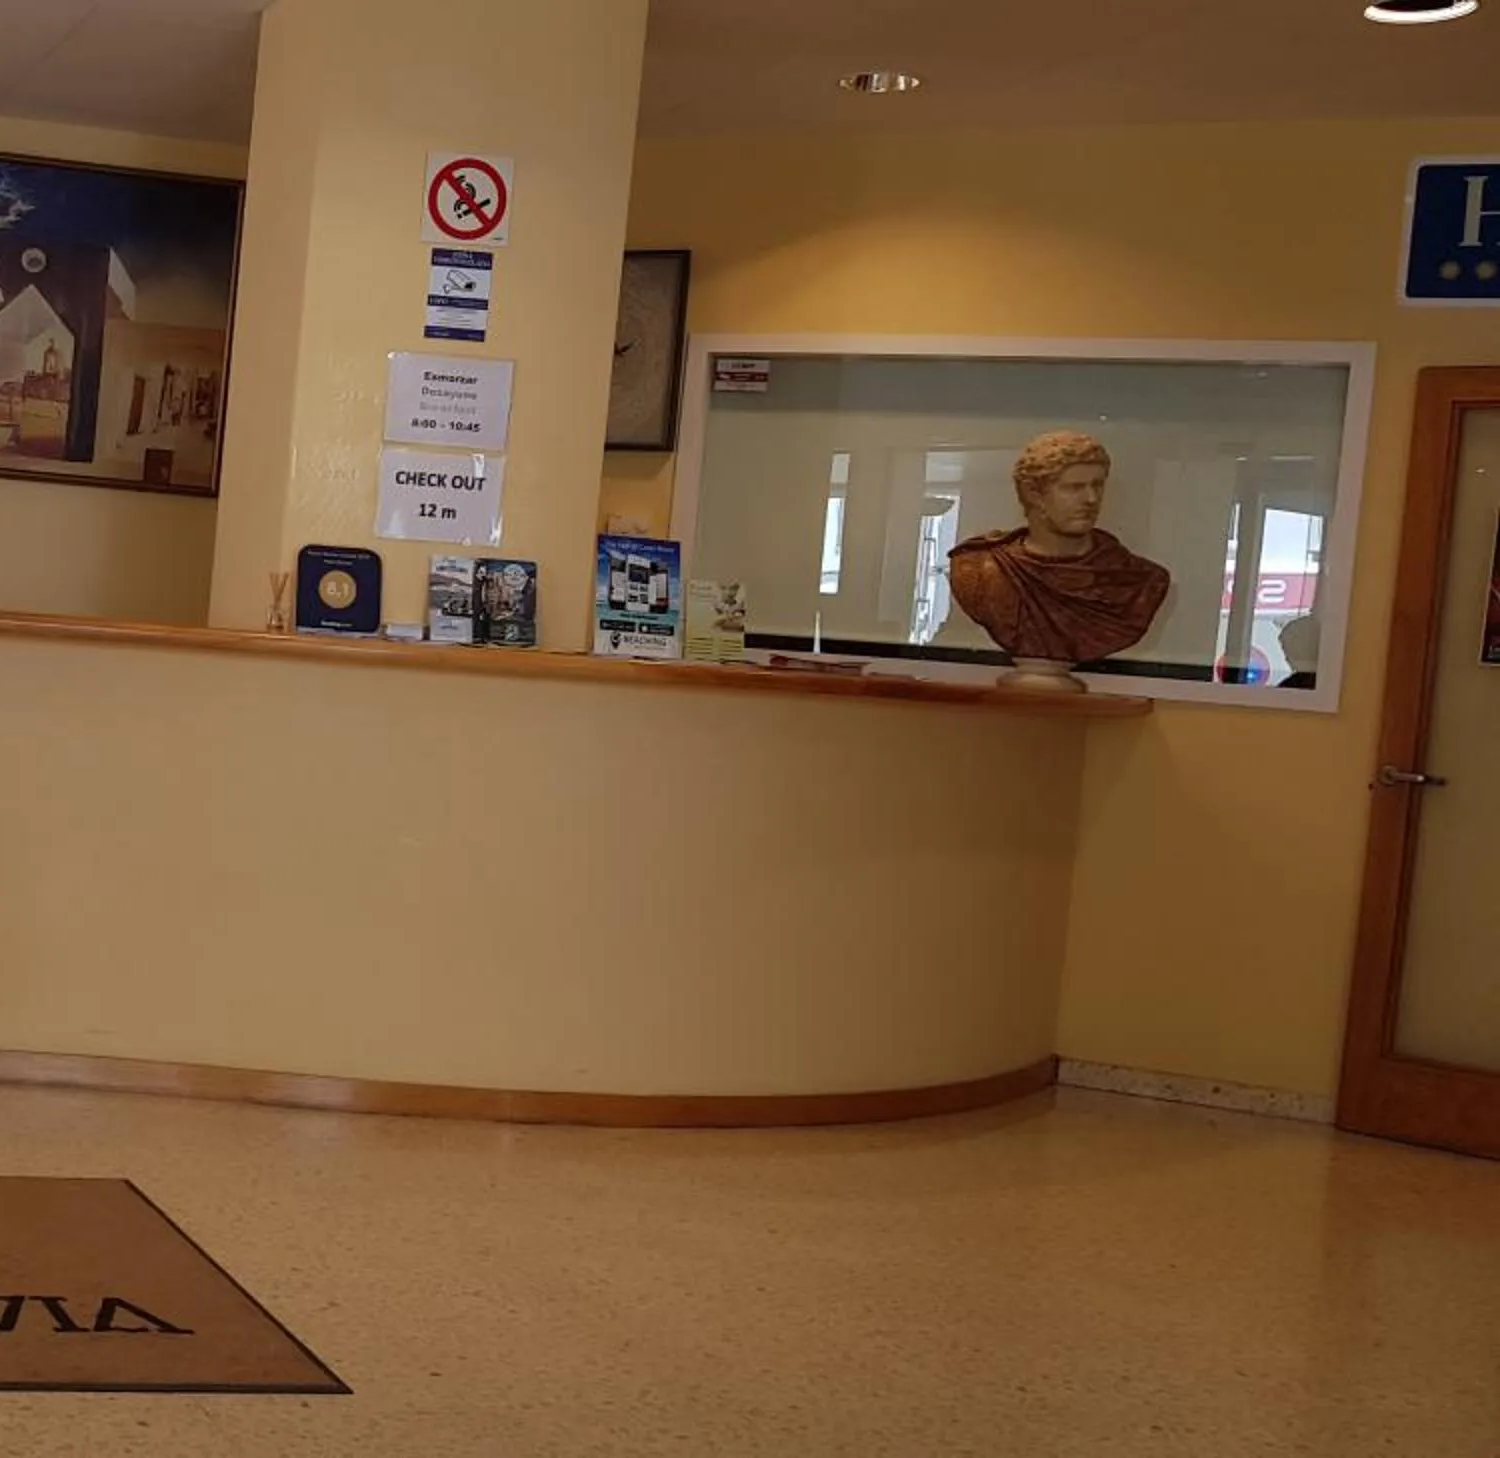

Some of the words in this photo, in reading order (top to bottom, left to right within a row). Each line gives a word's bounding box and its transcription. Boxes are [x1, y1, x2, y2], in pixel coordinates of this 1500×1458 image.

[411, 418, 437, 429] 8:00
[449, 421, 481, 433] 10:45
[395, 471, 447, 488] CHECK
[451, 475, 487, 491] OUT
[418, 503, 437, 518] 12
[441, 507, 457, 519] m
